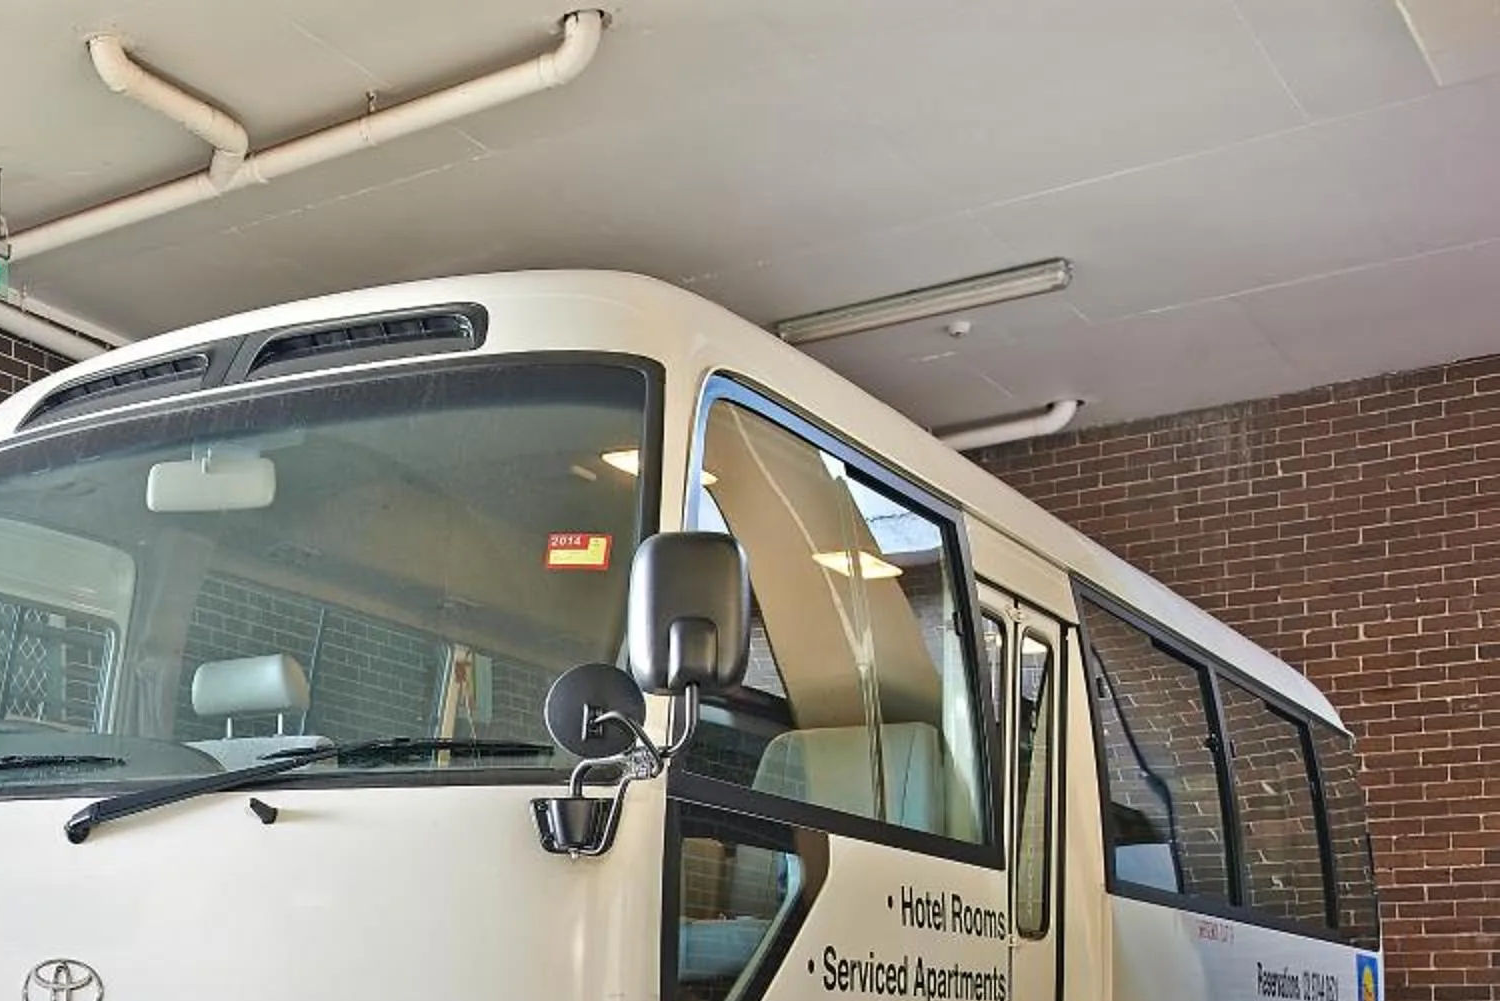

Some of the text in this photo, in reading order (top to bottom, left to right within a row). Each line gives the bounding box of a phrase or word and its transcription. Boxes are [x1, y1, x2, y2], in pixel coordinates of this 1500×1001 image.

[550, 535, 581, 546] 2014
[901, 885, 1005, 940] Hotel Rooms
[823, 946, 907, 996] Serviced
